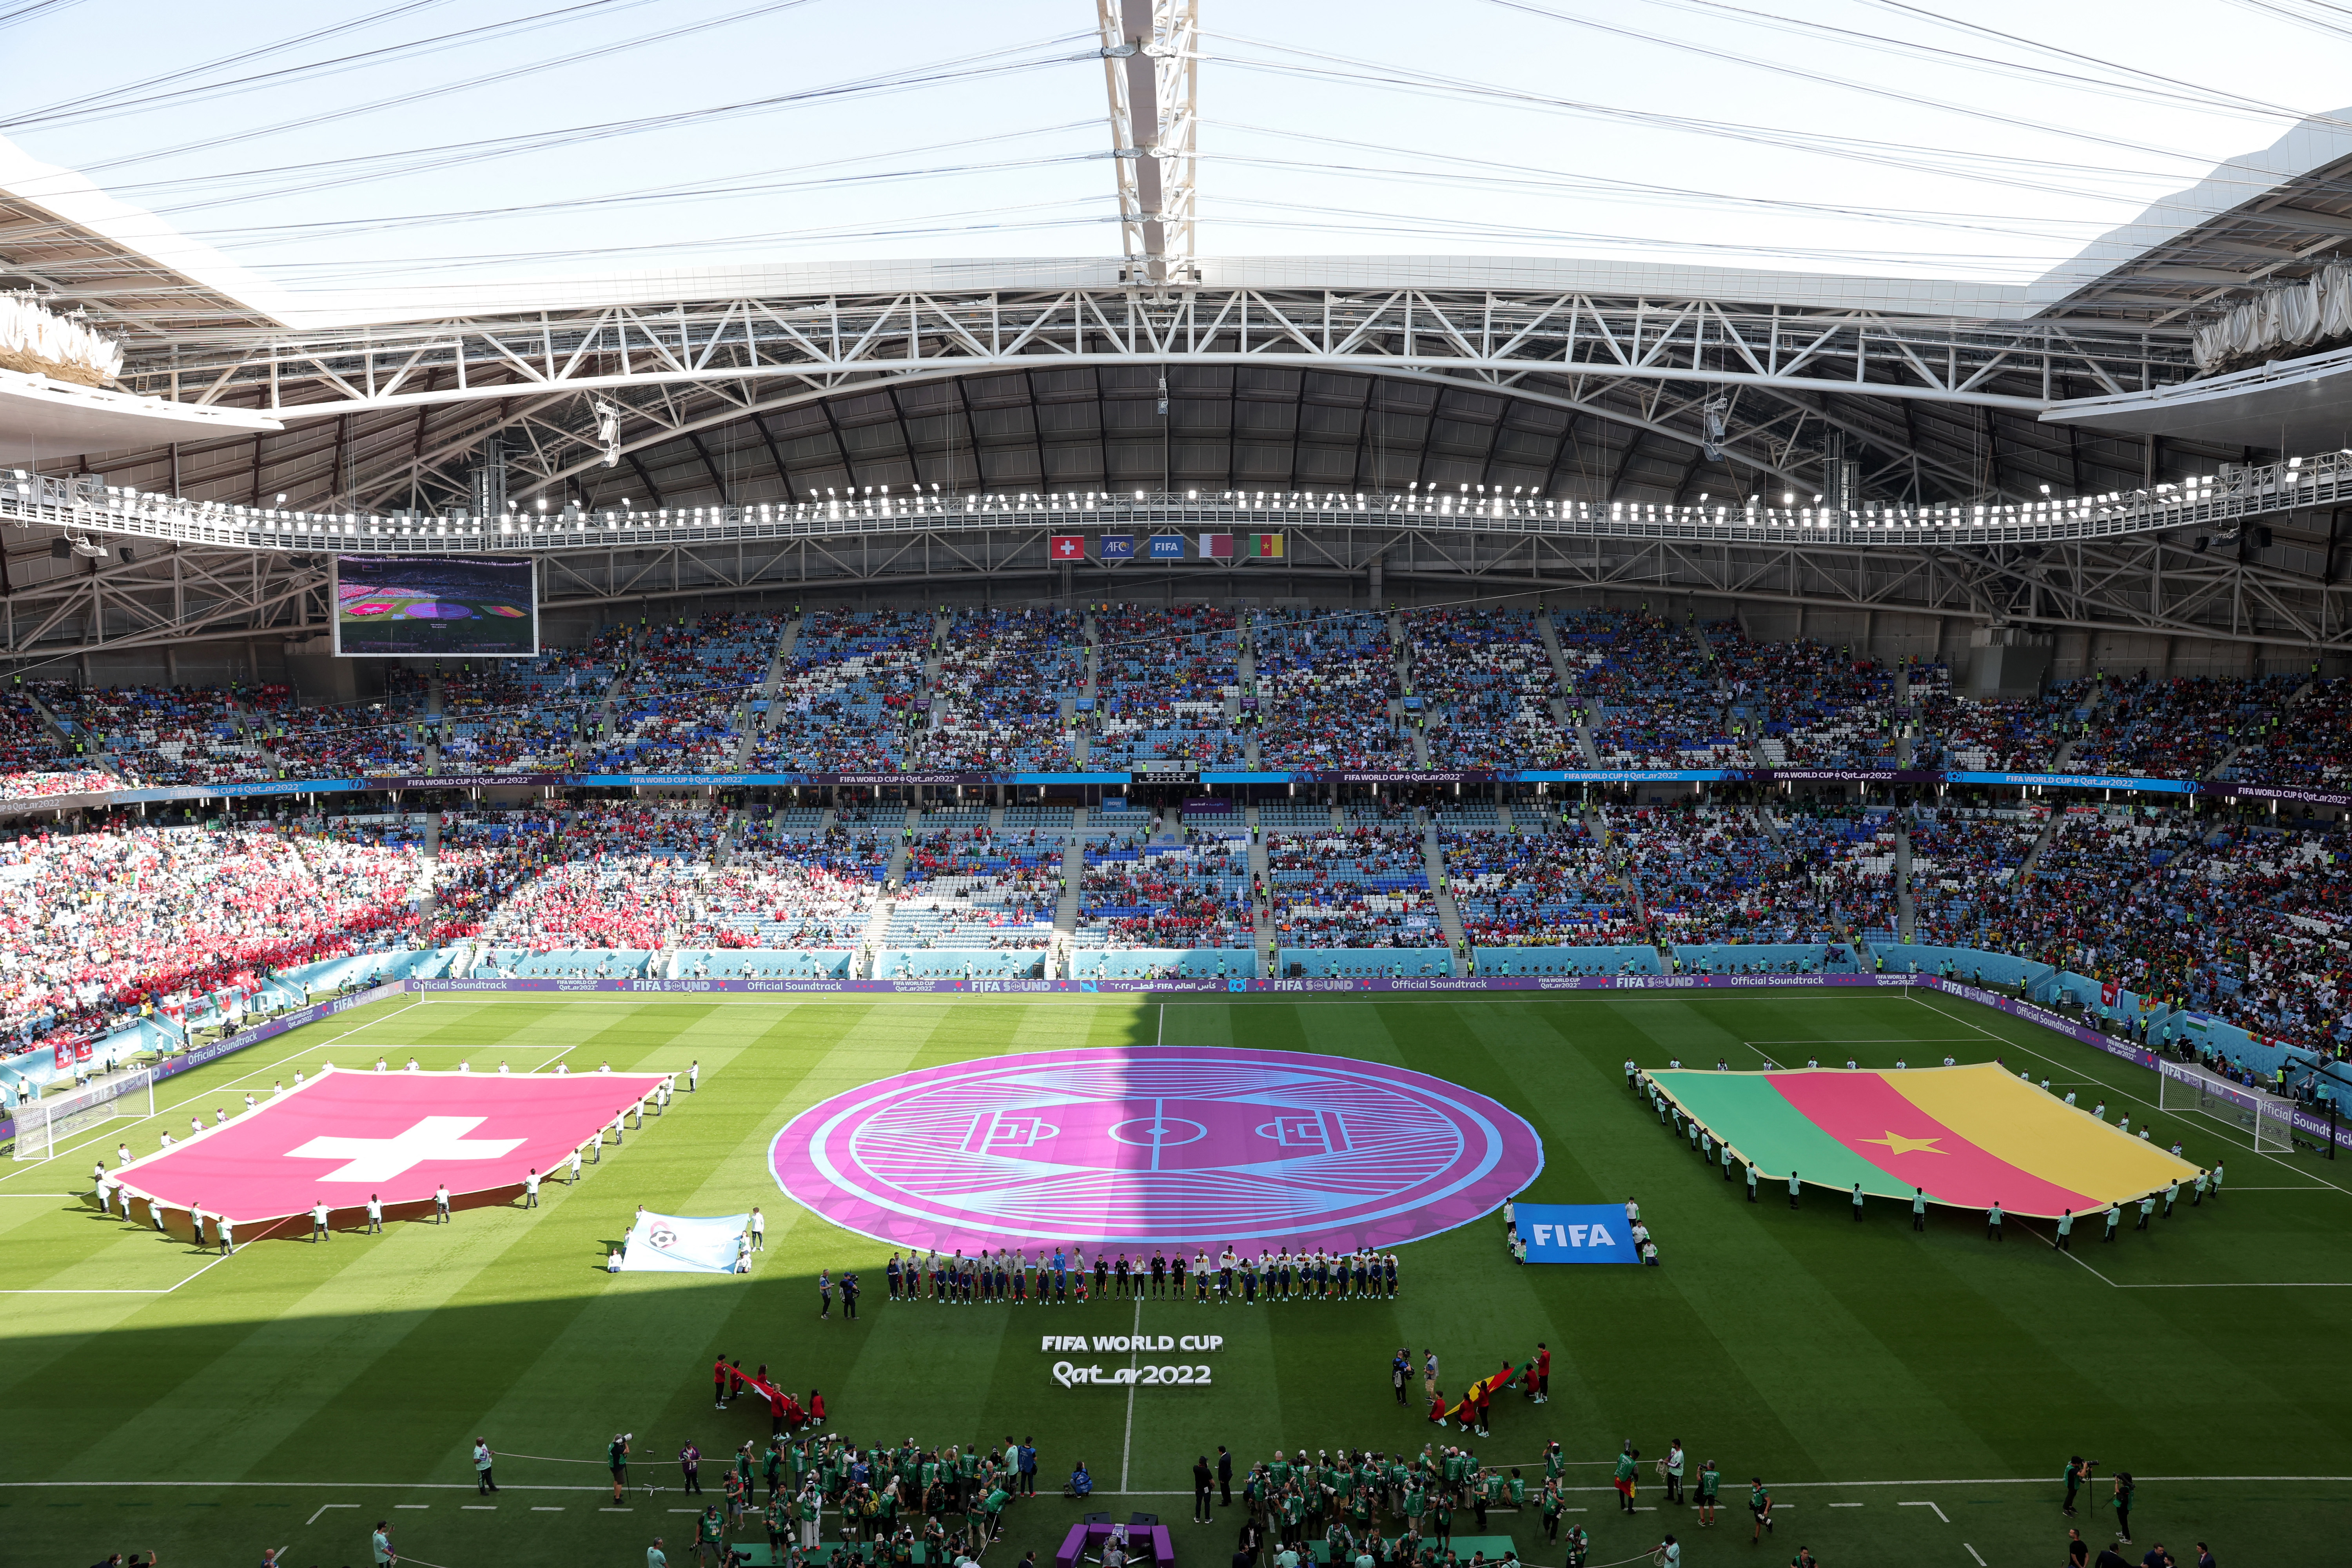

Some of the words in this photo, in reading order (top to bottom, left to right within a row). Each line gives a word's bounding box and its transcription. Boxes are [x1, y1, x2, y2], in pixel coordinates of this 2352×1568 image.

[1105, 542, 1129, 552] AFC
[170, 789, 189, 797] FIFA
[2258, 788, 2281, 797] WORLD
[1274, 980, 1303, 990] FIFA
[1306, 980, 1354, 990] SOUND
[1617, 978, 1644, 987] FIFA
[1648, 977, 1694, 987] SOUND
[1731, 976, 1766, 985] Official
[1769, 976, 1824, 984] Soundtrack
[633, 981, 661, 991] FIFA
[664, 981, 710, 991] SOUND
[972, 982, 1000, 991] FIFA
[1003, 982, 1051, 991] SOUND
[1197, 981, 1216, 991] كأس
[1942, 980, 1963, 996] FIFA
[1964, 987, 1995, 1005] SOUND
[333, 996, 353, 1013] FIFA
[355, 987, 388, 1006] SOUND
[294, 1012, 306, 1021] WORLD
[2017, 1004, 2040, 1021] Official
[2040, 1013, 2078, 1036] Soundtrack
[188, 1045, 215, 1064] Official
[216, 1030, 257, 1054] Soundtrack
[2116, 1041, 2129, 1051] WORLD
[2159, 1059, 2181, 1080] FIFA
[2257, 1100, 2291, 1122] Official
[2293, 1113, 2352, 1147] Soundtack
[1533, 1223, 1616, 1247] FIFA
[1042, 1336, 1089, 1352] FIFA
[1093, 1336, 1174, 1352] WORLD
[1180, 1335, 1223, 1351] CUP
